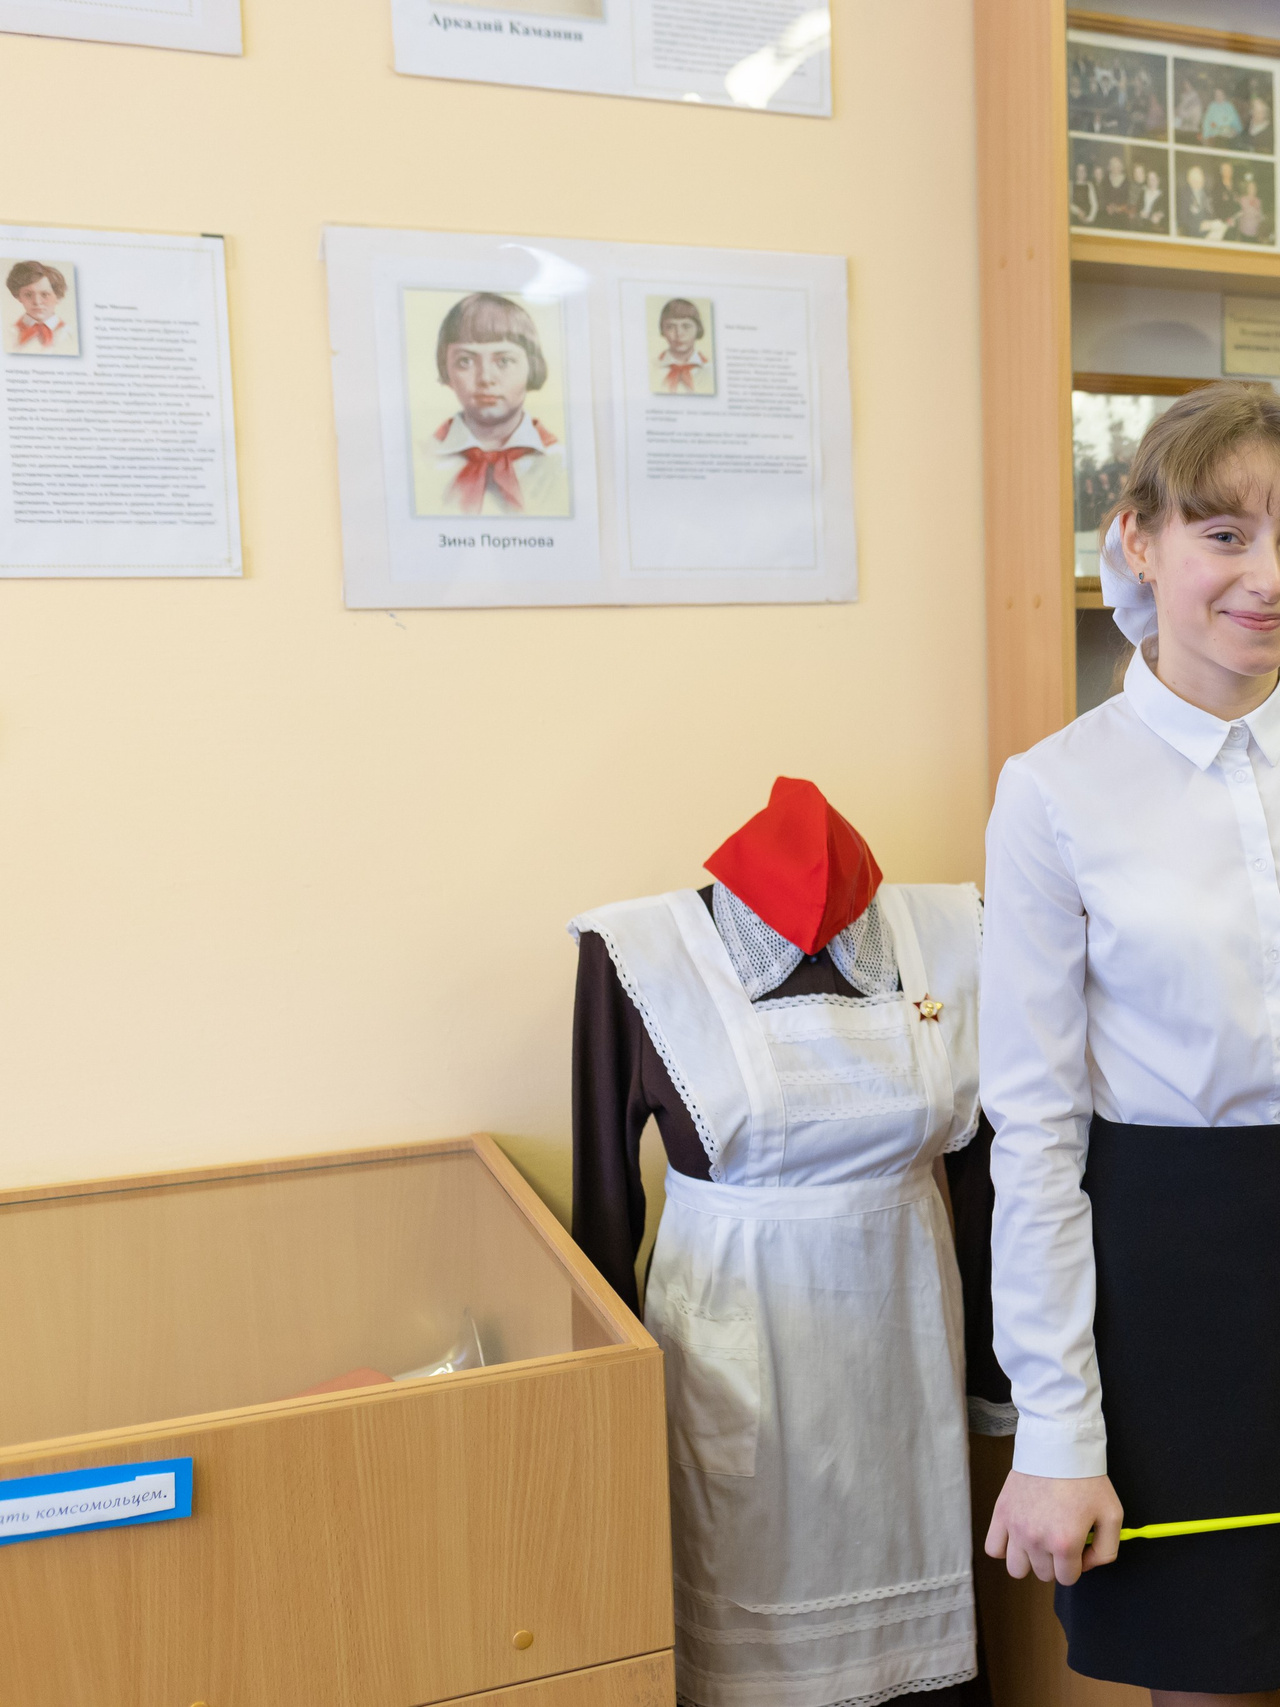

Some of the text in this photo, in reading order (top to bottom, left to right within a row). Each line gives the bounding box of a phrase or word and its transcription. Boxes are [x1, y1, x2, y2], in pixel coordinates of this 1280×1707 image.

[429, 13, 583, 42] Аркадий Каманин
[438, 533, 554, 550] Зина Портнова
[36, 1489, 168, 1519] комсомольцем.
